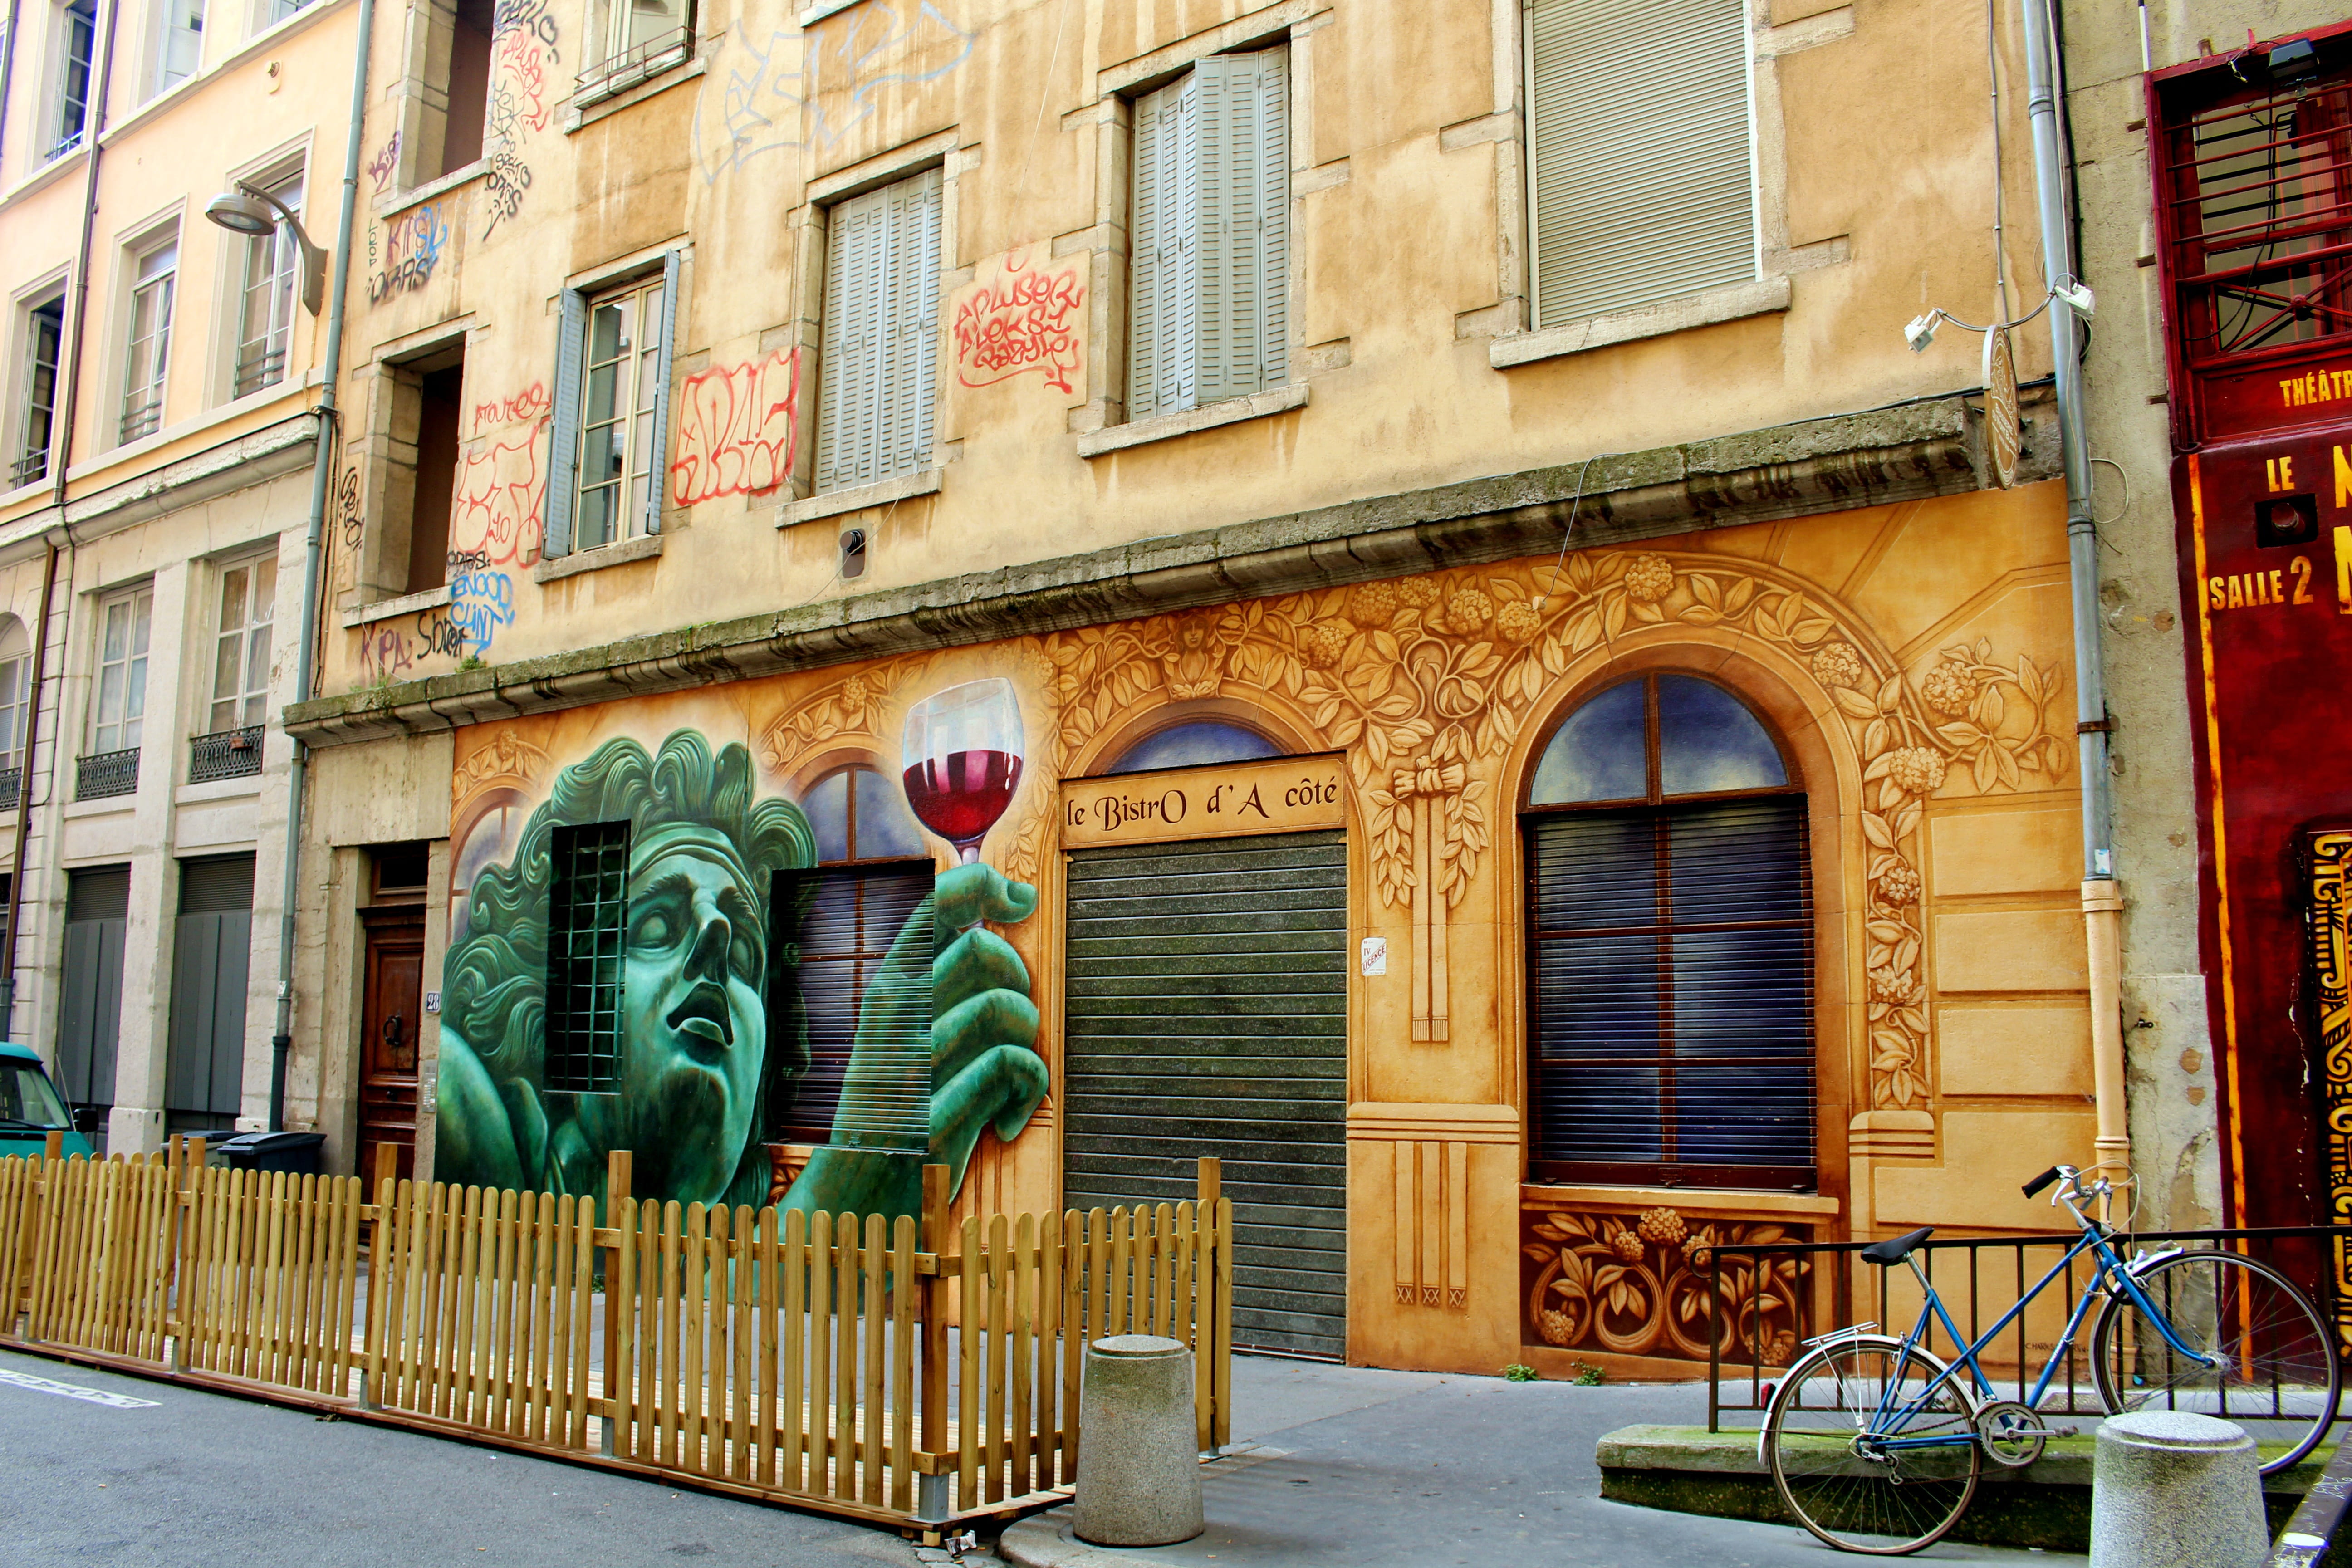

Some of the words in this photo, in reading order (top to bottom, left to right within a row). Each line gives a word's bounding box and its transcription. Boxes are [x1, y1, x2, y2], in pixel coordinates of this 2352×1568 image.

[2267, 456, 2294, 492] LE
[2210, 569, 2284, 610] SALLE
[2290, 555, 2313, 605] 2
[1068, 799, 1085, 826] le
[1285, 776, 1337, 807] côté
[1363, 945, 1385, 971] LICENCE
[427, 994, 439, 1009] 28
